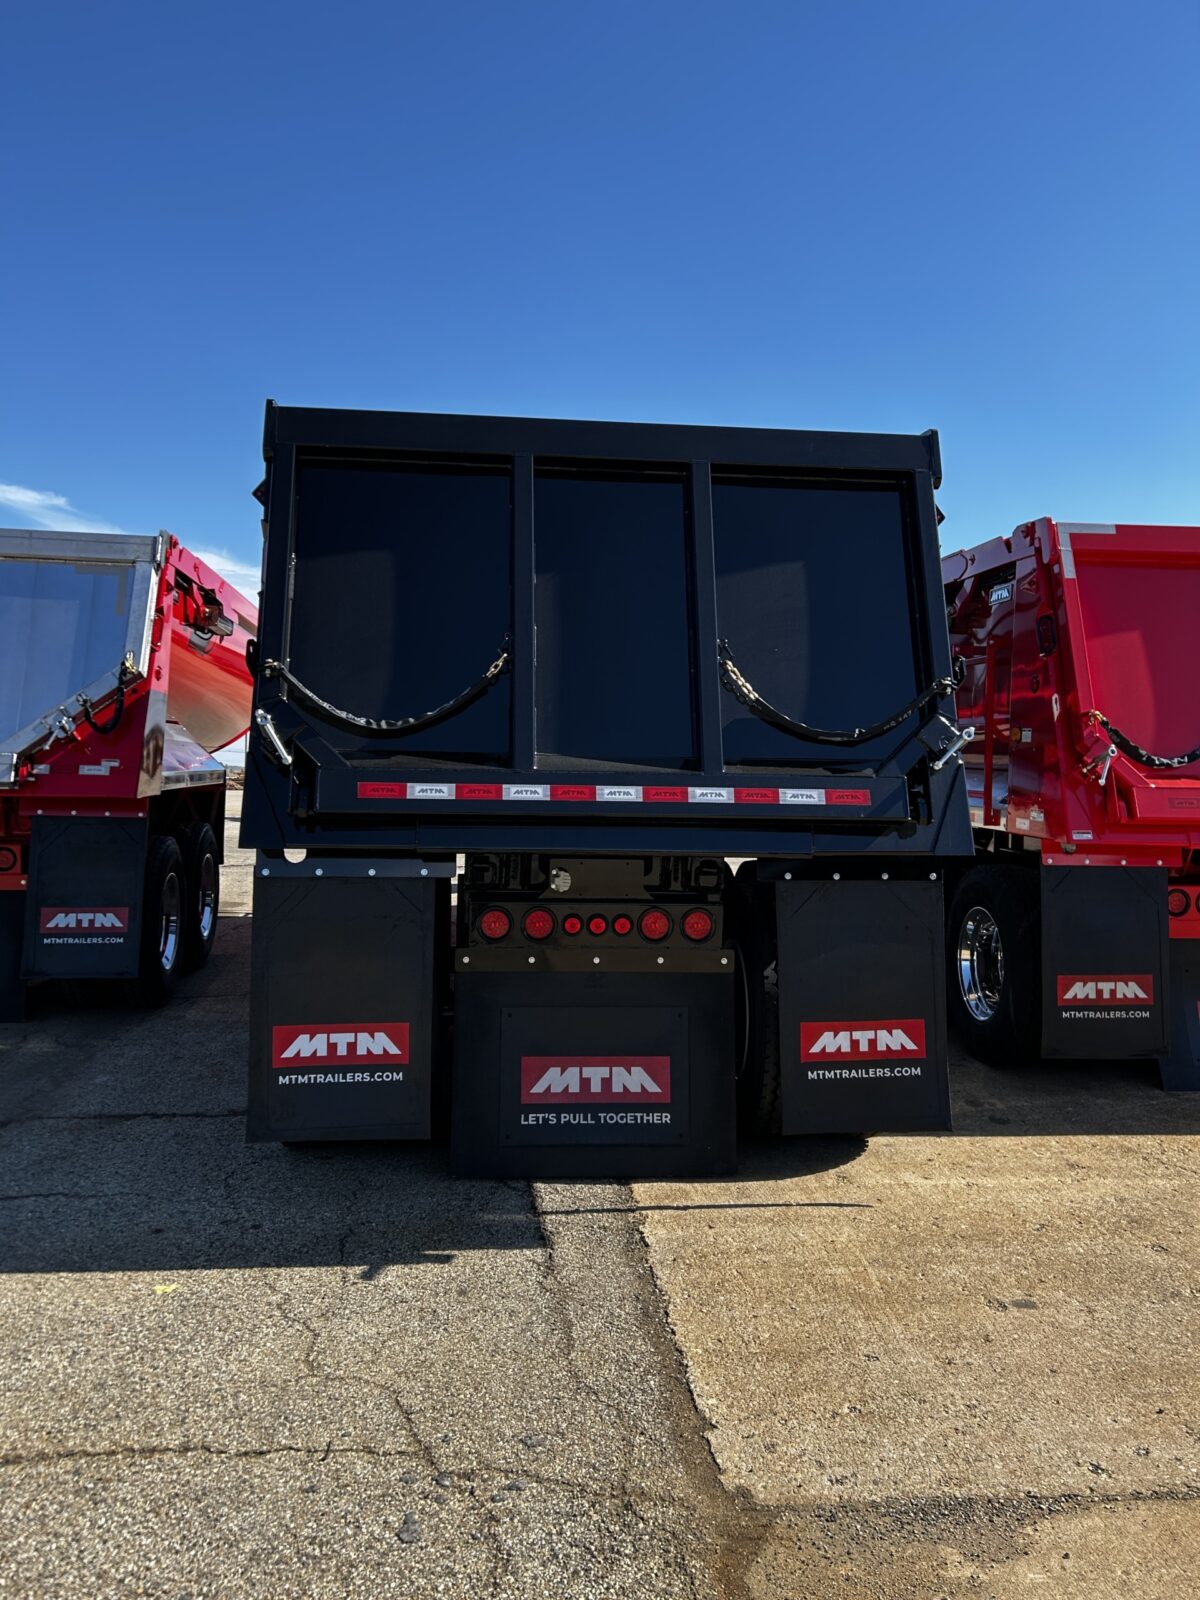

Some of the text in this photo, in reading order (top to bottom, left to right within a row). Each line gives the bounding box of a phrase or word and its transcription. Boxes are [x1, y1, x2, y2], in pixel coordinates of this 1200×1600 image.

[991, 588, 1010, 602] MTM
[45, 913, 123, 927] MTM
[1063, 981, 1149, 999] MTM
[280, 1032, 402, 1058] MTM
[808, 1028, 918, 1053] MTM
[278, 1071, 403, 1085] MTMTRAILERS.COM
[529, 1066, 662, 1093] MTM
[807, 1067, 921, 1080] MTMTRAILERS.COM
[520, 1112, 671, 1125] LET'S PULL TOGETHER
